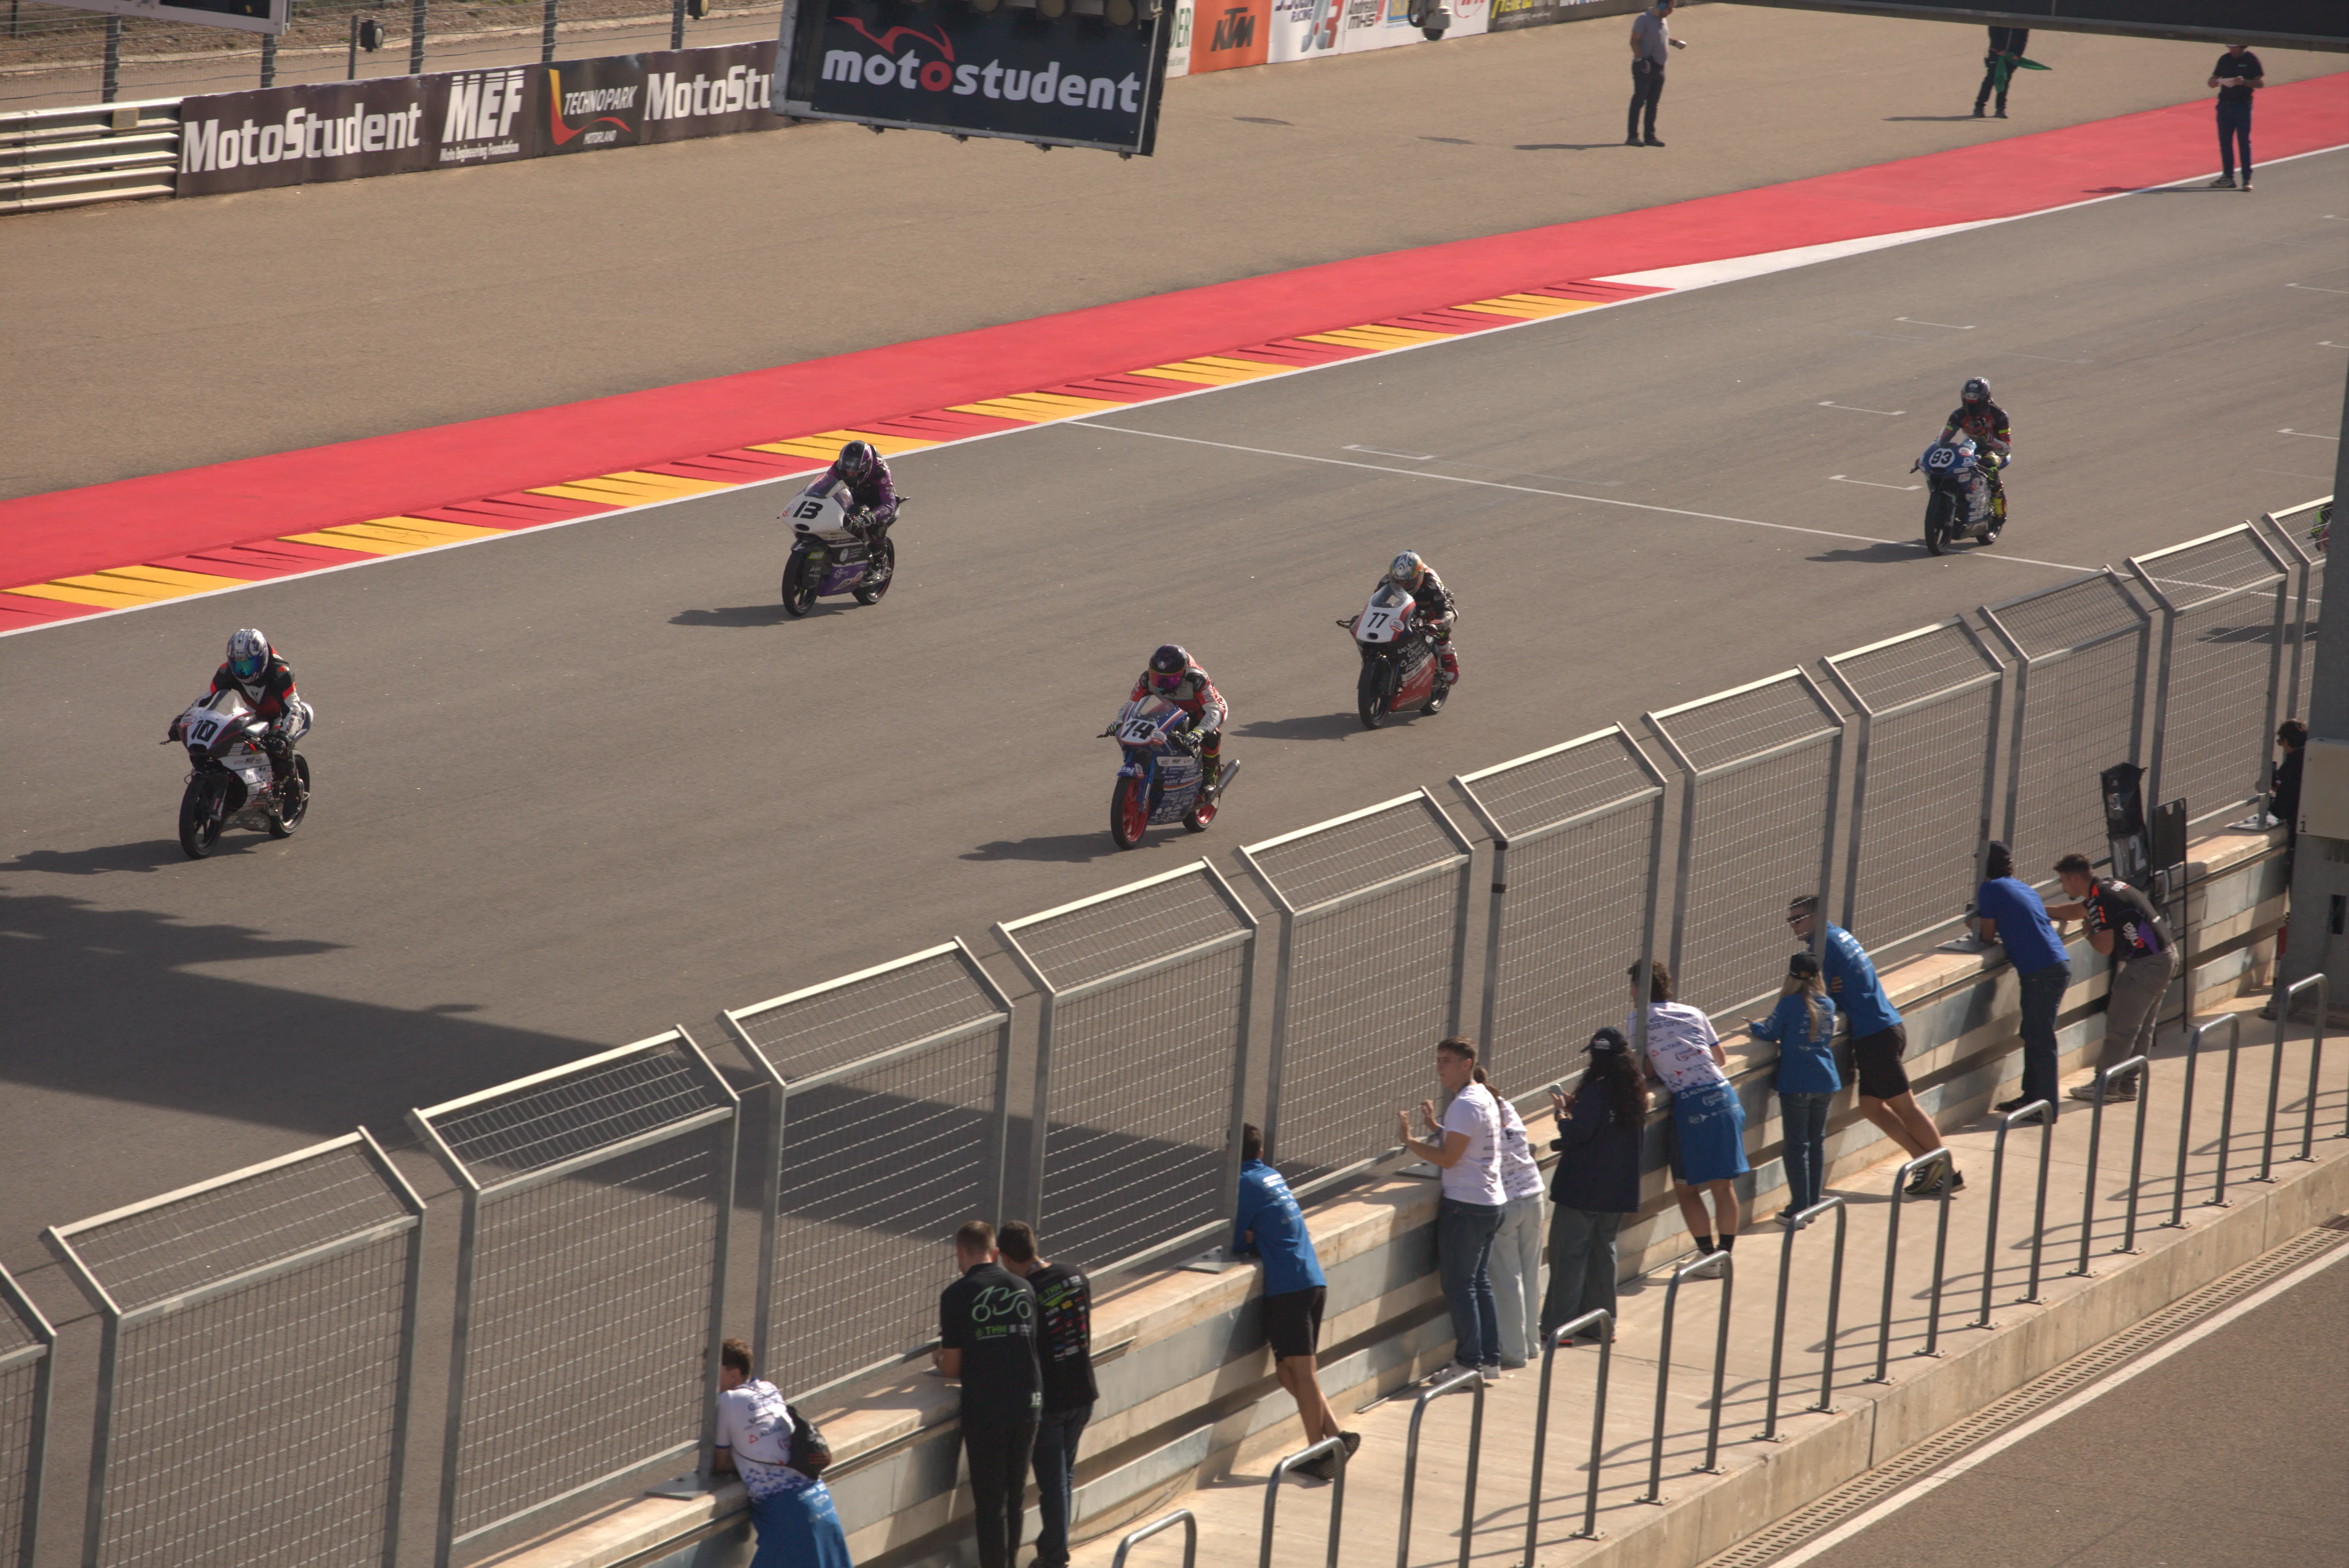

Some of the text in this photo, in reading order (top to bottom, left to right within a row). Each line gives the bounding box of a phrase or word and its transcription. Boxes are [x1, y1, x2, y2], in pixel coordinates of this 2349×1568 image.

[1210, 7, 1256, 52] KTM
[822, 49, 1140, 113] motostudent
[441, 70, 525, 143] MEF
[563, 85, 638, 115] TECHNOPARK
[181, 102, 422, 173] MotoStudent
[583, 130, 617, 145] MOTORLAND
[439, 148, 456, 161] Moto
[1931, 451, 1952, 464] 93
[792, 501, 823, 519] 13
[191, 720, 218, 742] 10
[1121, 720, 1156, 740] 14
[2299, 820, 2307, 833] 1
